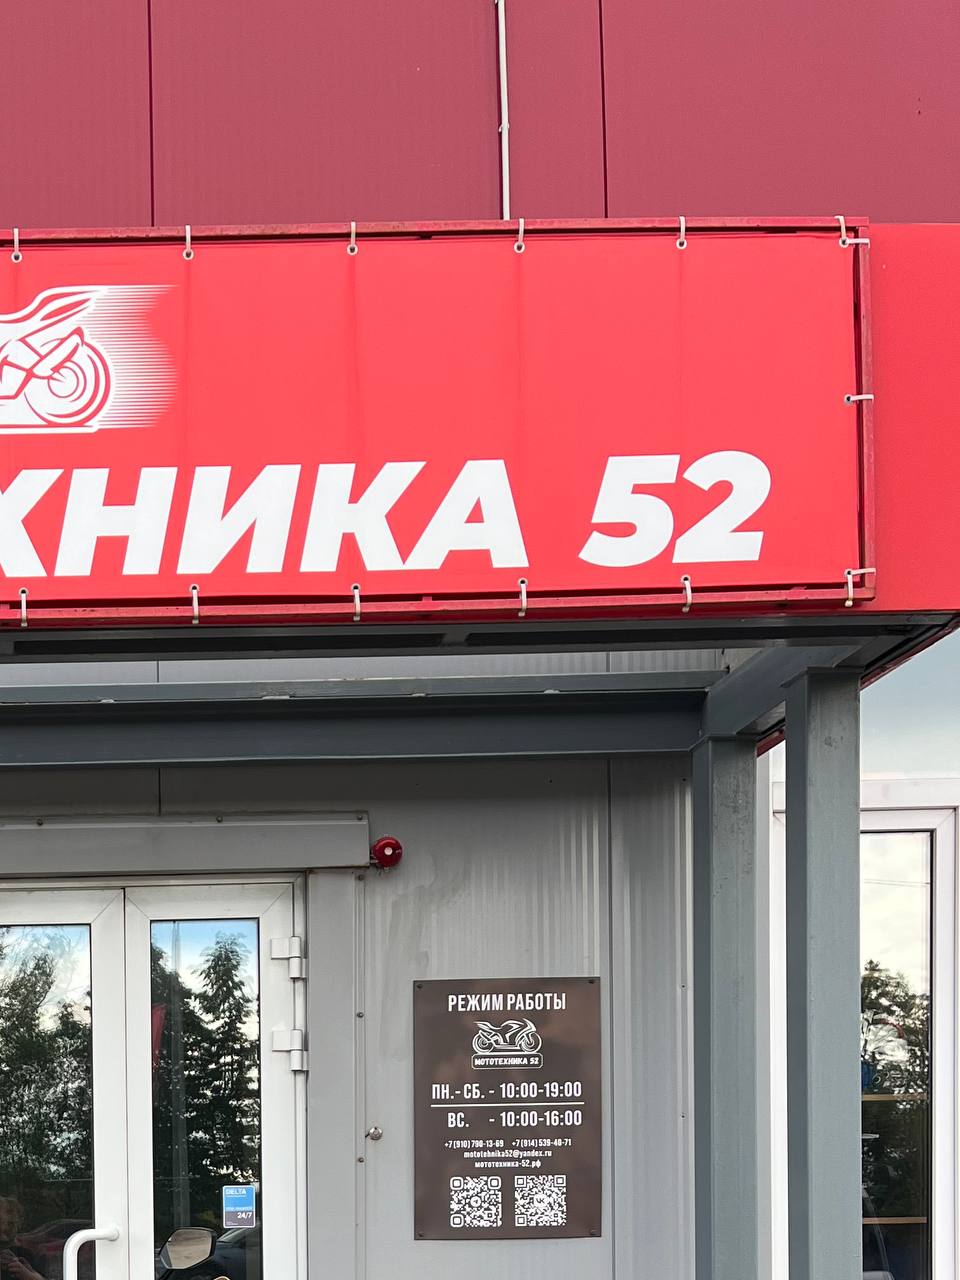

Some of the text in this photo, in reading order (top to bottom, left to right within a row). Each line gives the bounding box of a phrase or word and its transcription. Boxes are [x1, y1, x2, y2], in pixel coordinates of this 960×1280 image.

[578, 450, 772, 568] 52
[448, 992, 566, 1012] РЕЖИМ РАБОТЫ
[474, 1057, 539, 1066] МОТОТЕХНИКА 52
[499, 1081, 582, 1099] 10:00-19:00
[447, 1111, 470, 1128] ВС.
[499, 1109, 582, 1127] 10:00-16:00
